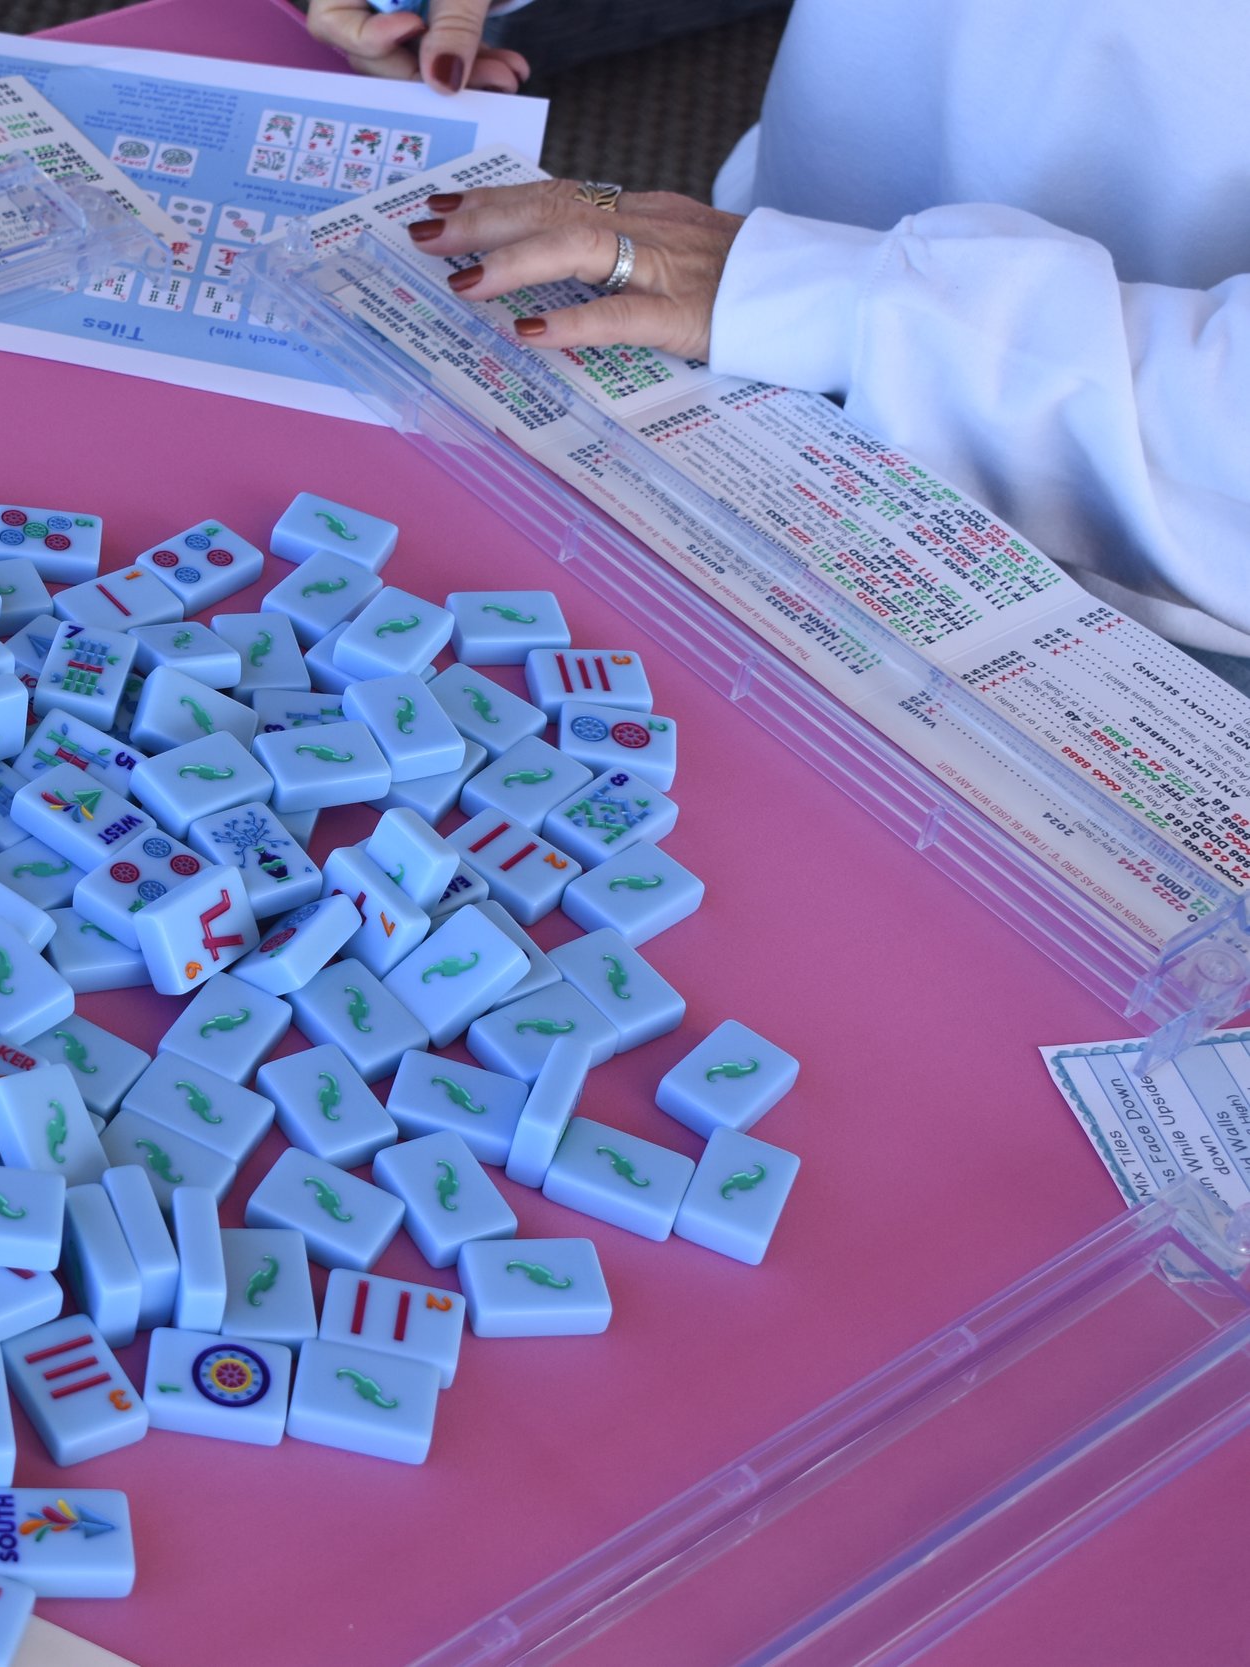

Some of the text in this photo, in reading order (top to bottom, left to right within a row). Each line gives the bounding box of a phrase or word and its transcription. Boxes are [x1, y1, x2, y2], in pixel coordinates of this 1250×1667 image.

[83, 315, 145, 343] Tiles
[353, 297, 443, 362] WINDS DRAGONS
[565, 450, 606, 478] VALUES
[683, 543, 728, 575] QUINTS
[762, 594, 866, 675] FF 11111 22 33333
[114, 751, 137, 771] 5
[1123, 715, 1243, 800] ANY LIKE NUMBERS
[610, 772, 629, 786] 8
[1057, 744, 1172, 829] 222 444 6666 8888
[97, 812, 144, 846] WEST
[1039, 811, 1076, 836] 2024
[543, 852, 568, 870] 2
[1114, 856, 1189, 912] 2222 4444
[1110, 1078, 1166, 1164] Face Down
[1140, 1076, 1203, 1173] While Upside
[1217, 1111, 1248, 1152] Walls
[1110, 1130, 1152, 1197] Mix Tiles
[1200, 1135, 1230, 1175] down
[424, 1292, 453, 1313] 2
